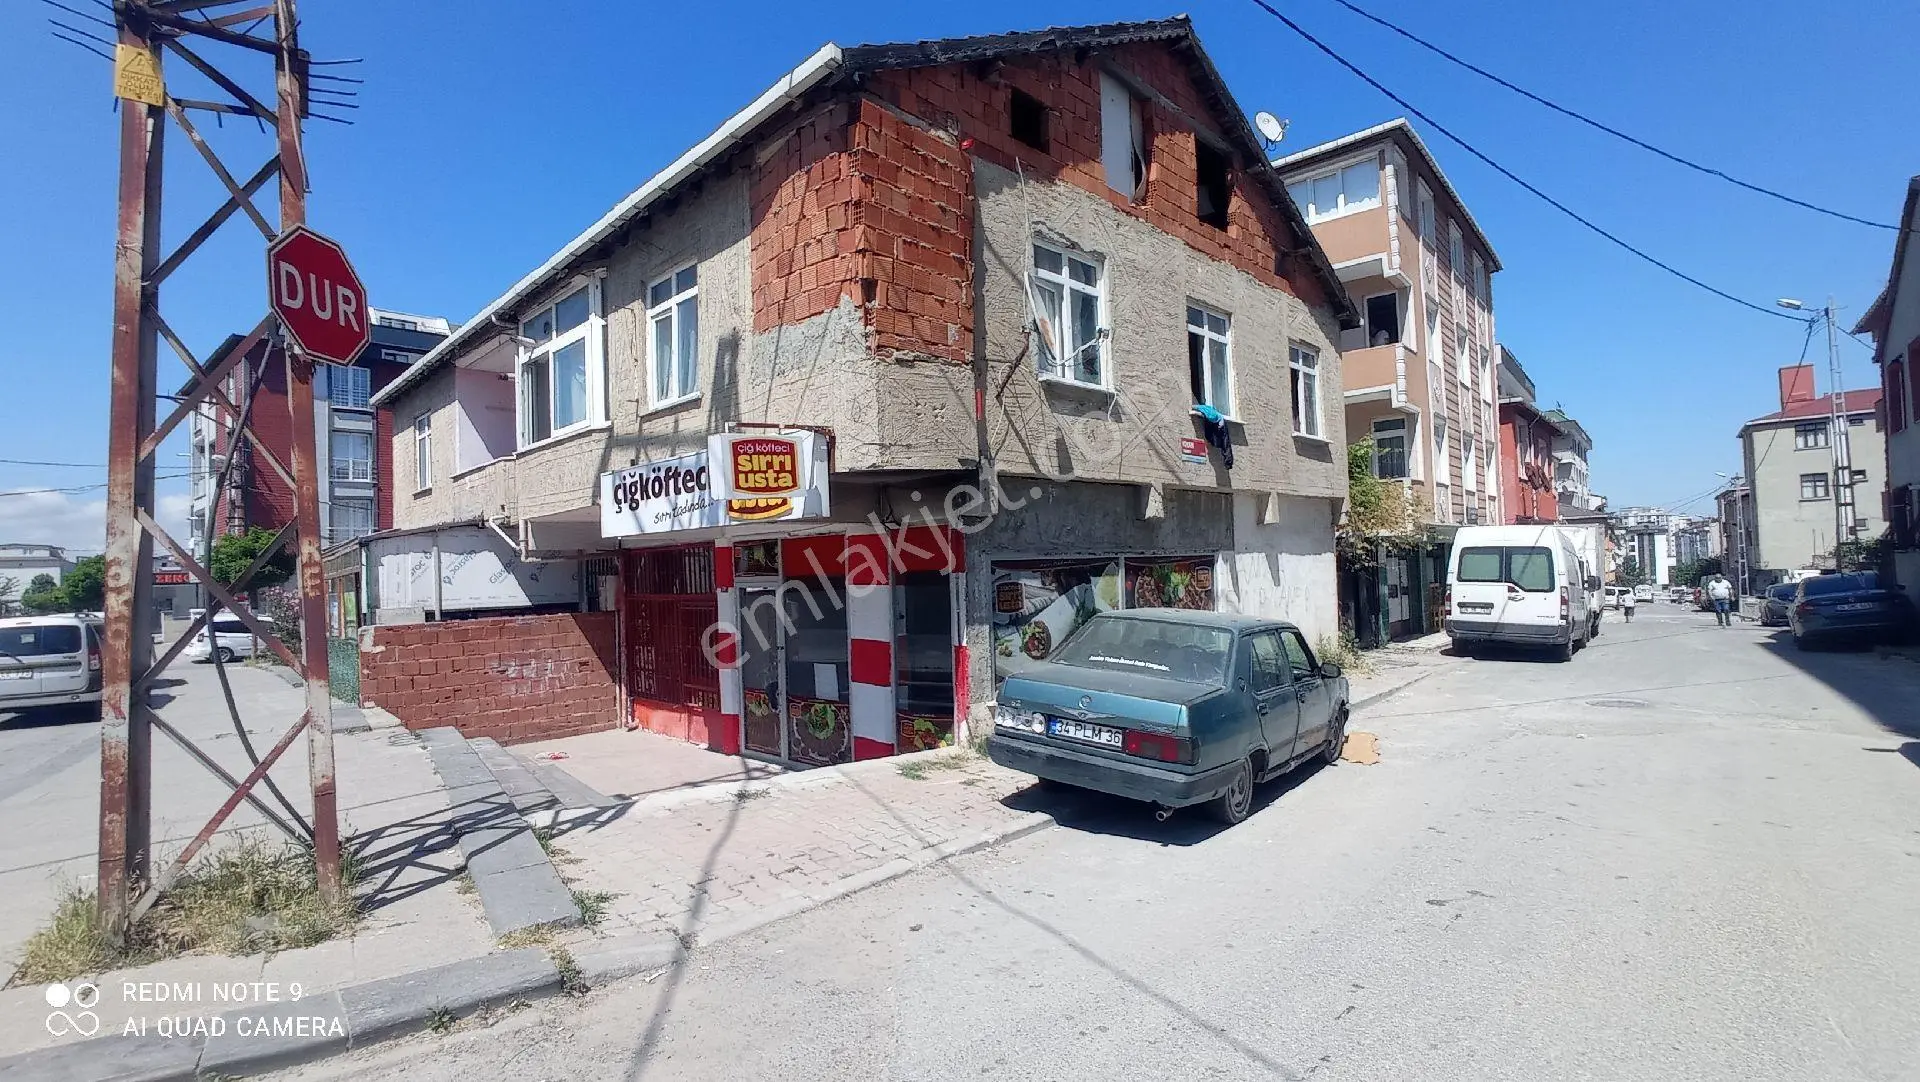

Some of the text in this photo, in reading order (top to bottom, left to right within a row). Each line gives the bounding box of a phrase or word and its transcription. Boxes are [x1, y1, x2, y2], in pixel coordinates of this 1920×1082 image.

[279, 260, 360, 332] DUR
[613, 464, 710, 513] çiğköftec
[738, 469, 793, 488] usta
[1056, 719, 1121, 744] 34 PLM 36
